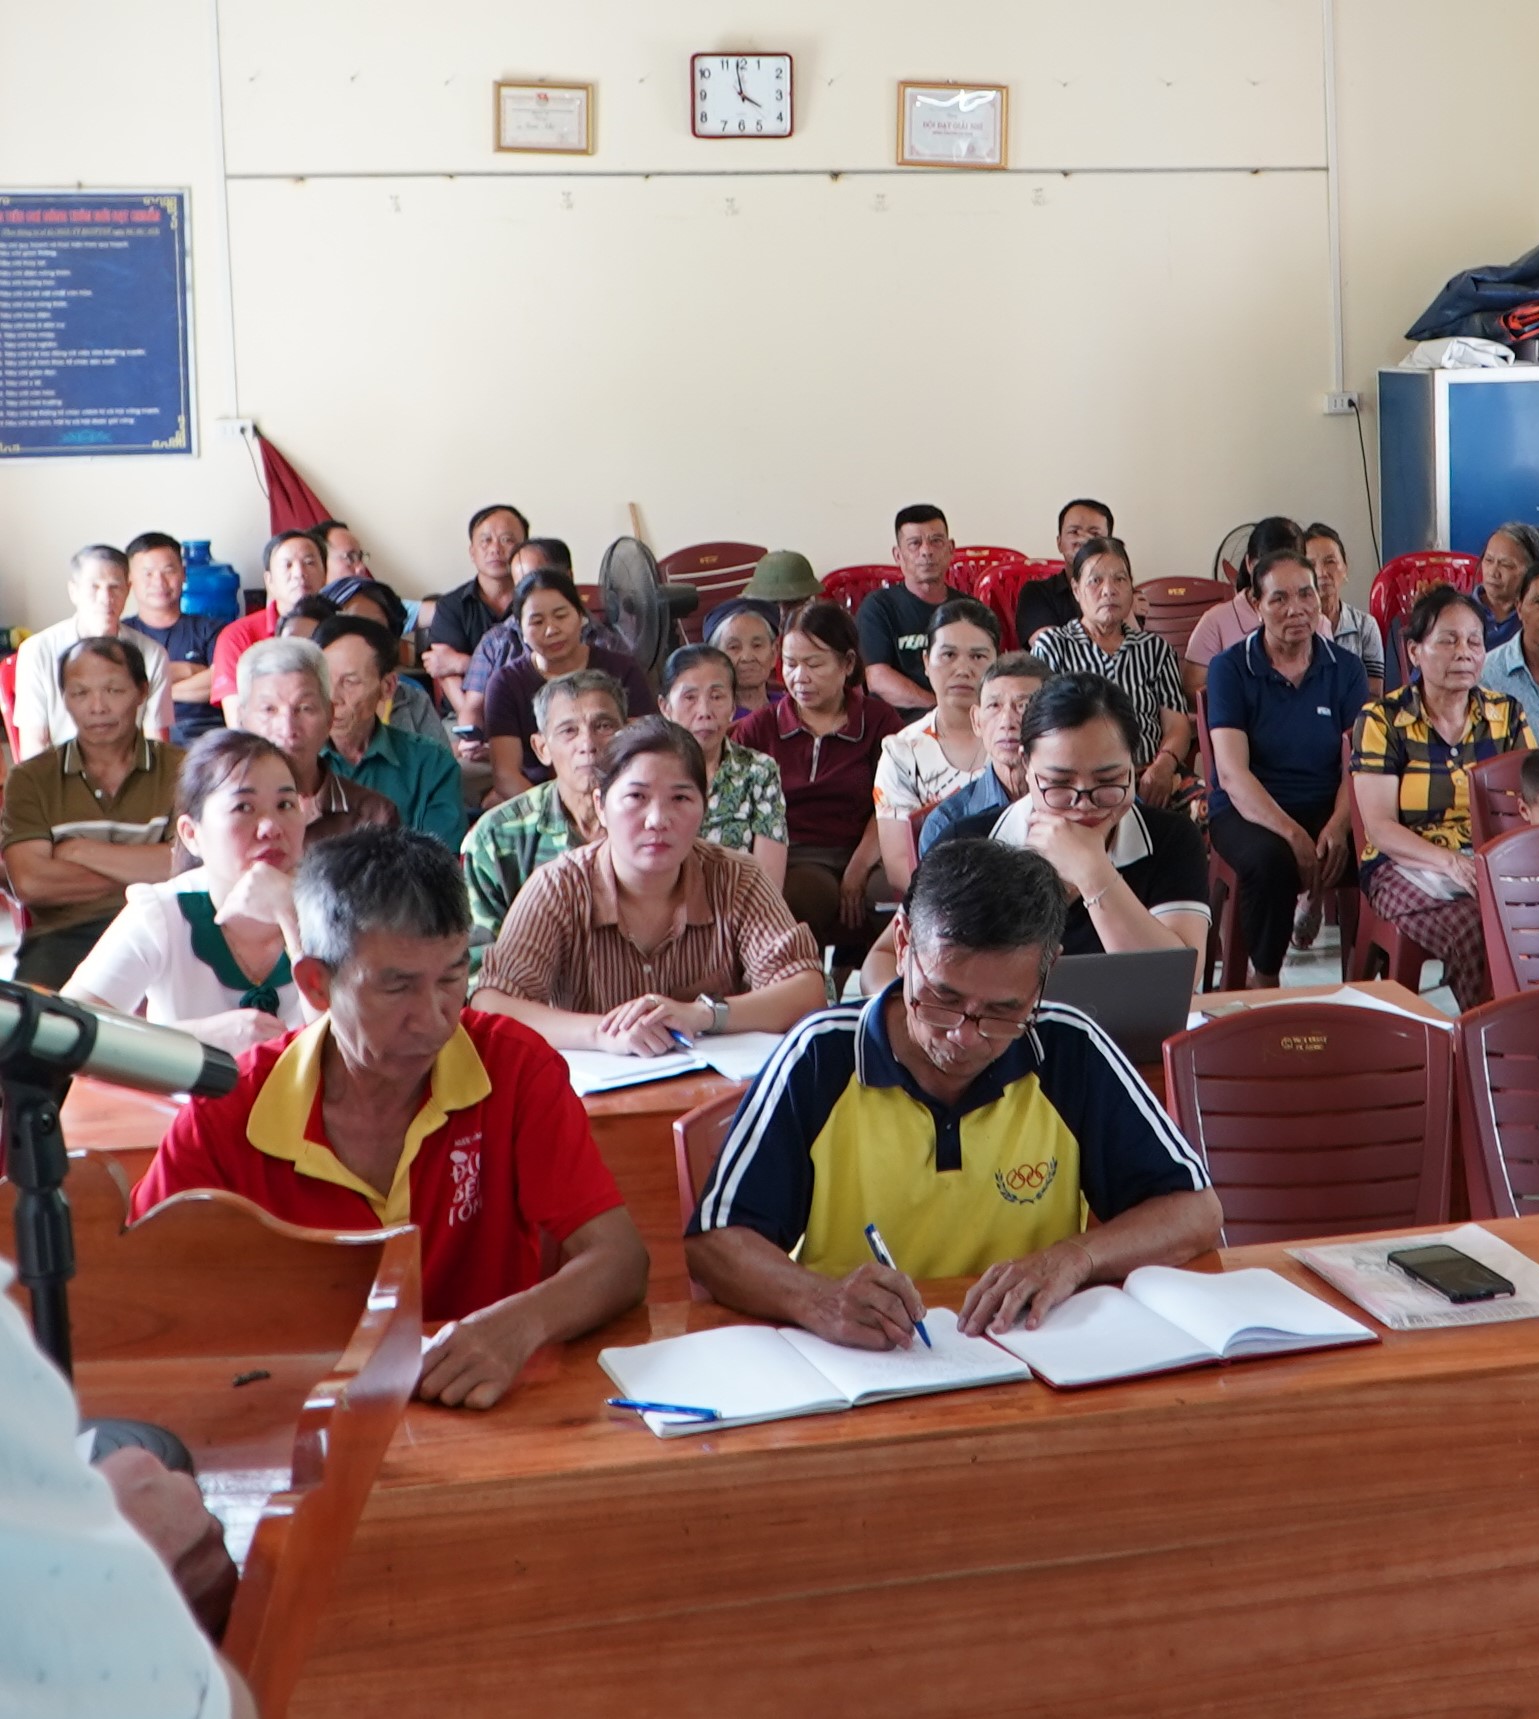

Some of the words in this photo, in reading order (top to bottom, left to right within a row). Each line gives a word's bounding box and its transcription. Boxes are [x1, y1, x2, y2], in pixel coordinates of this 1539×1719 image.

[721, 58, 729, 71] 11
[699, 68, 711, 80] 10
[775, 68, 783, 79] 2
[700, 89, 707, 101] 9
[776, 89, 783, 101] 3
[700, 111, 708, 123] 8
[776, 111, 783, 123] 4
[721, 120, 728, 132] 7
[738, 119, 746, 132] 6
[756, 119, 763, 132] 5
